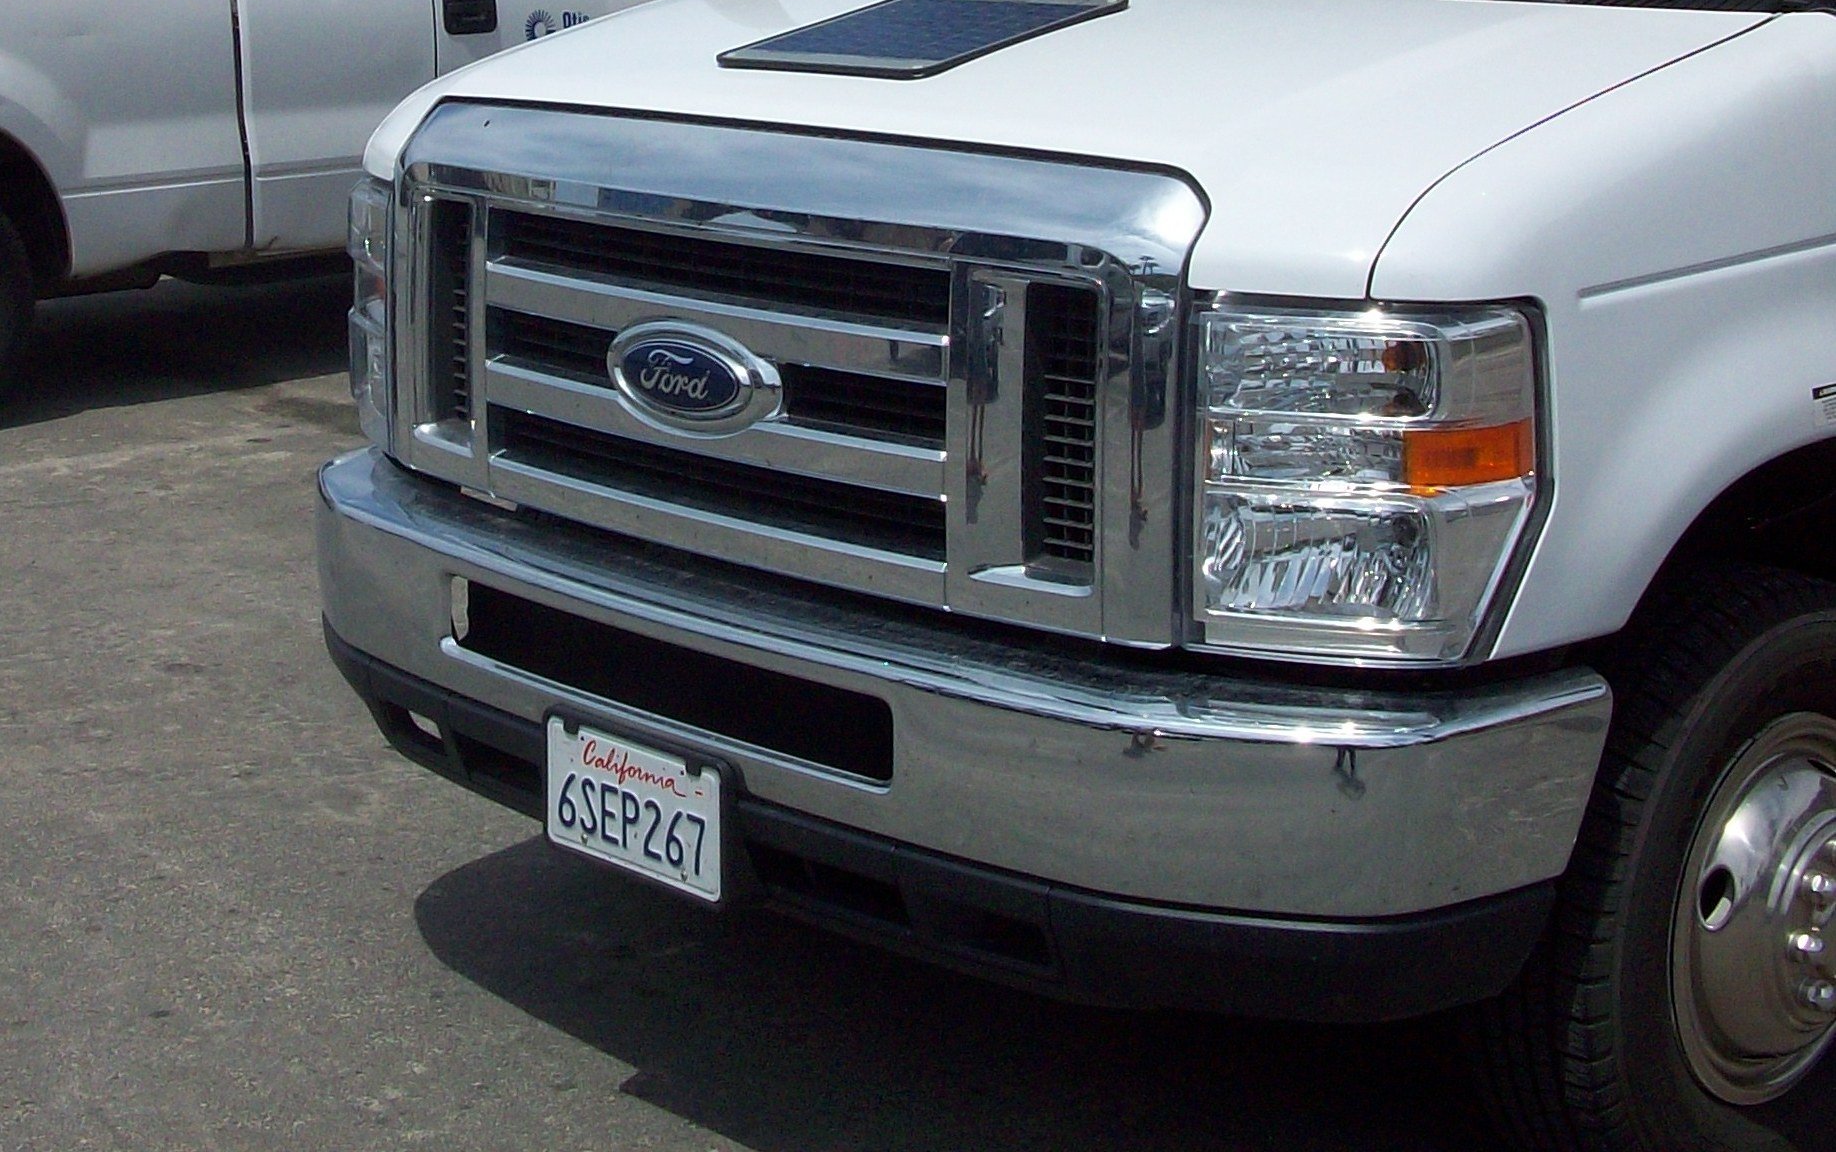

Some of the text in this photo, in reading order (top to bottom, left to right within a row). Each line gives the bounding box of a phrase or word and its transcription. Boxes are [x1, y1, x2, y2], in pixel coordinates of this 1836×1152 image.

[639, 349, 711, 400] Ford
[583, 739, 688, 798] California
[557, 772, 707, 876] 6SEP267
